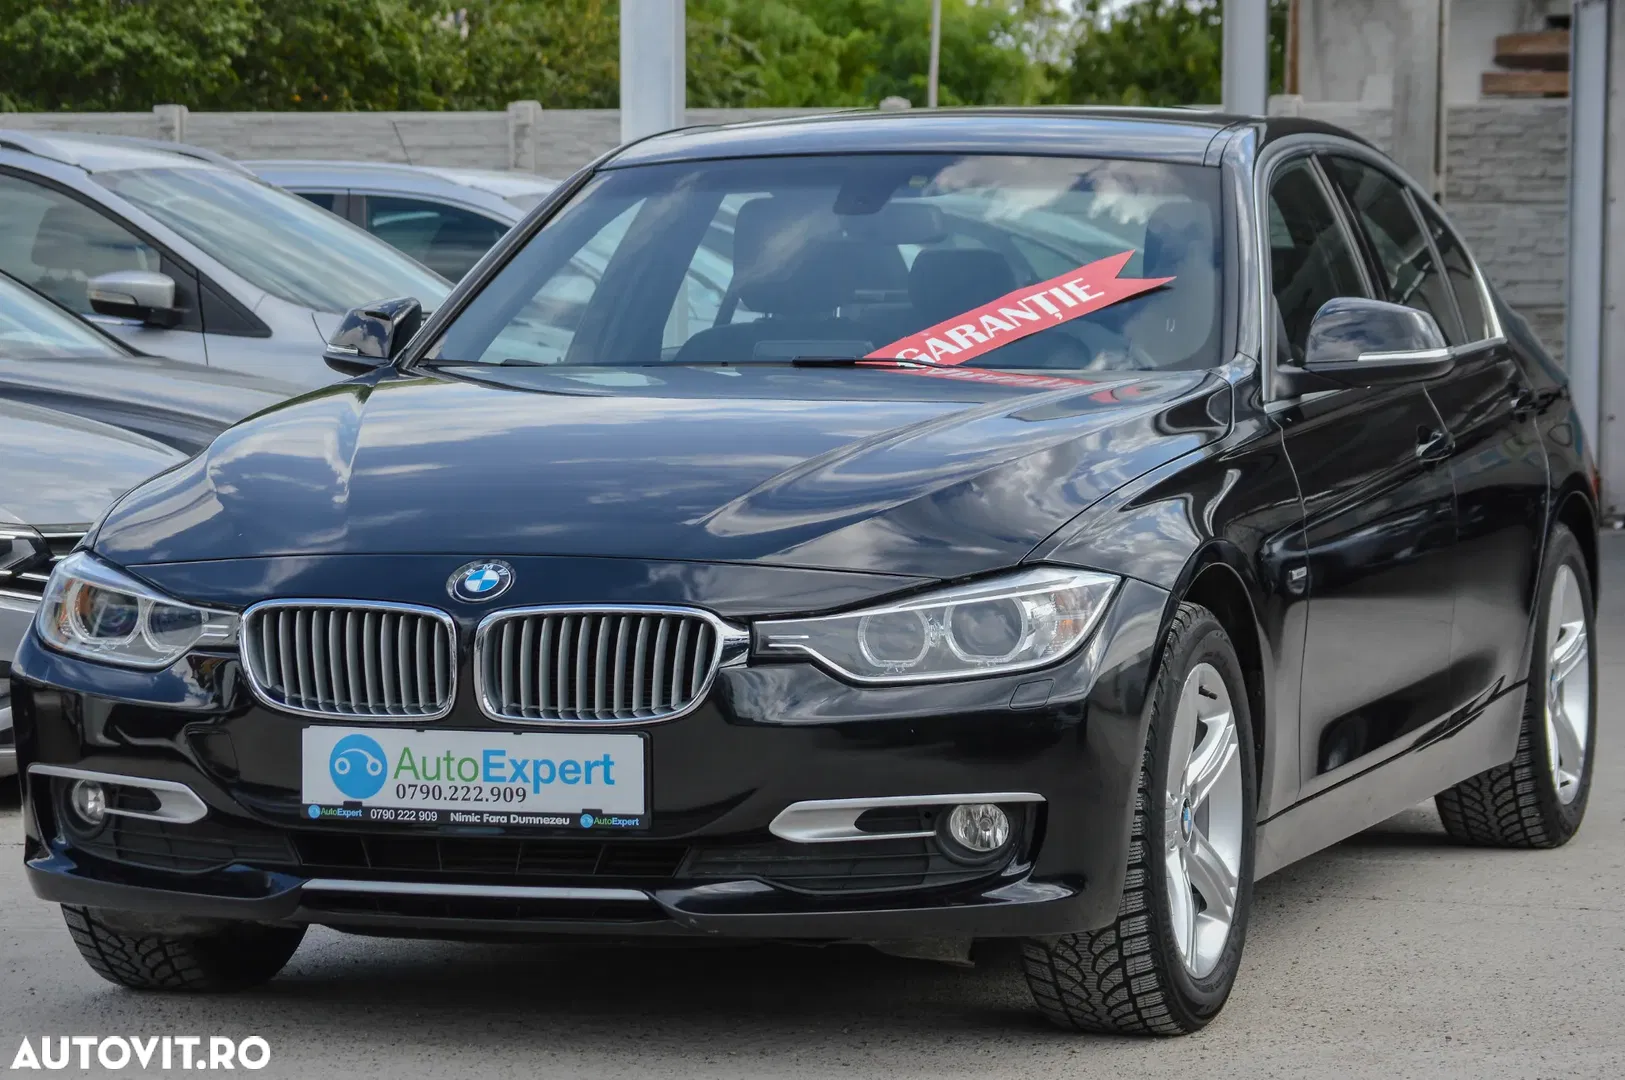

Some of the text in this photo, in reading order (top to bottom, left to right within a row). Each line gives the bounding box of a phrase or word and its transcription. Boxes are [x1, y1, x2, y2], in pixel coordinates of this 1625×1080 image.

[465, 564, 509, 576] BMW
[393, 747, 615, 794] AutoExpert
[396, 783, 527, 803] 0790.222.909
[320, 807, 362, 818] AutoExpert
[370, 808, 438, 822] 0790 222 909
[450, 812, 570, 825] Nimic Fara Dumnezeu
[593, 816, 639, 827] AutoExpert
